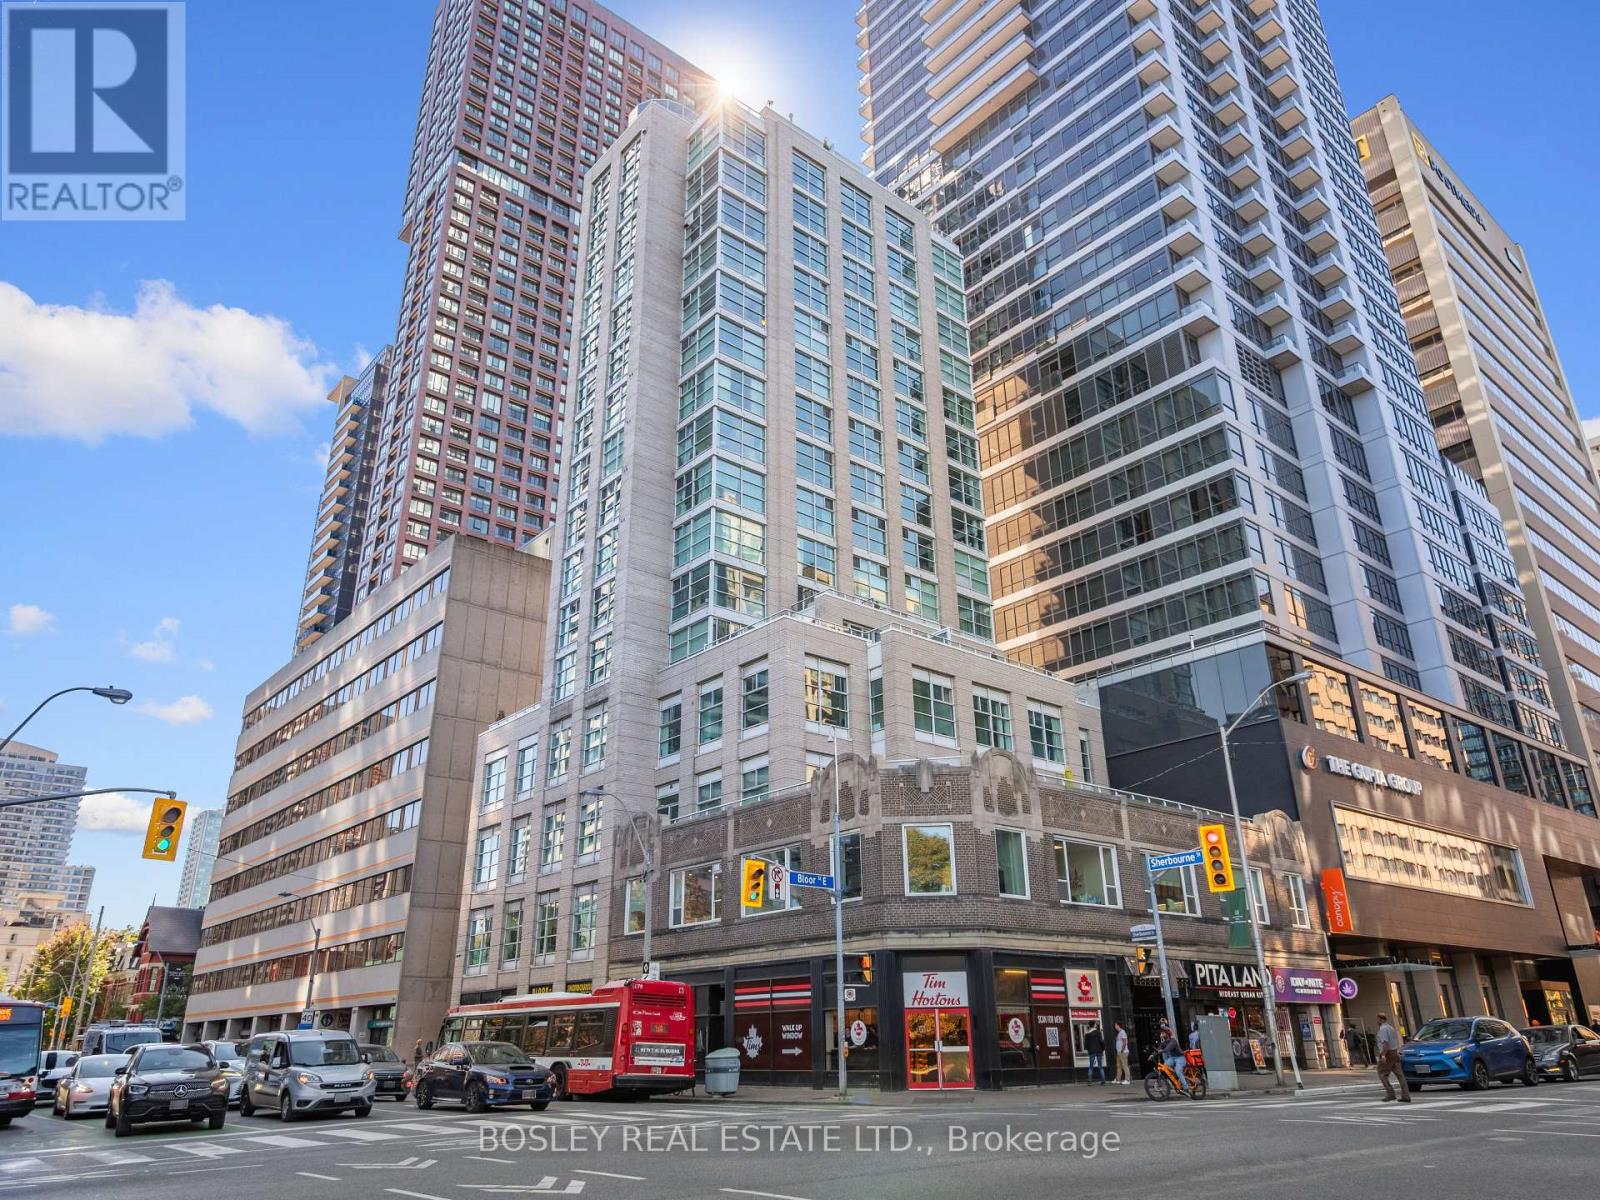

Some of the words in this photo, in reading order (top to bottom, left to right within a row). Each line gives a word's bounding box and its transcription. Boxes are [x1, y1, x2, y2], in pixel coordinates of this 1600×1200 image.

[1326, 755, 1352, 777] THE
[1351, 762, 1388, 787] GUPTA
[1387, 773, 1423, 796] GROUP
[1150, 854, 1196, 868] Sherbourne
[797, 873, 816, 885] Bloor
[822, 876, 828, 886] E
[1329, 886, 1345, 927] canopy
[922, 973, 946, 989] Tim
[1195, 963, 1232, 987] PITA
[911, 990, 961, 1006] Hortons
[1240, 990, 1256, 999] URBAN
[302, 1014, 313, 1022] 40
[1037, 1015, 1047, 1024] SCAN
[1054, 1015, 1064, 1024] MENU
[781, 1031, 803, 1040] WINDOW
